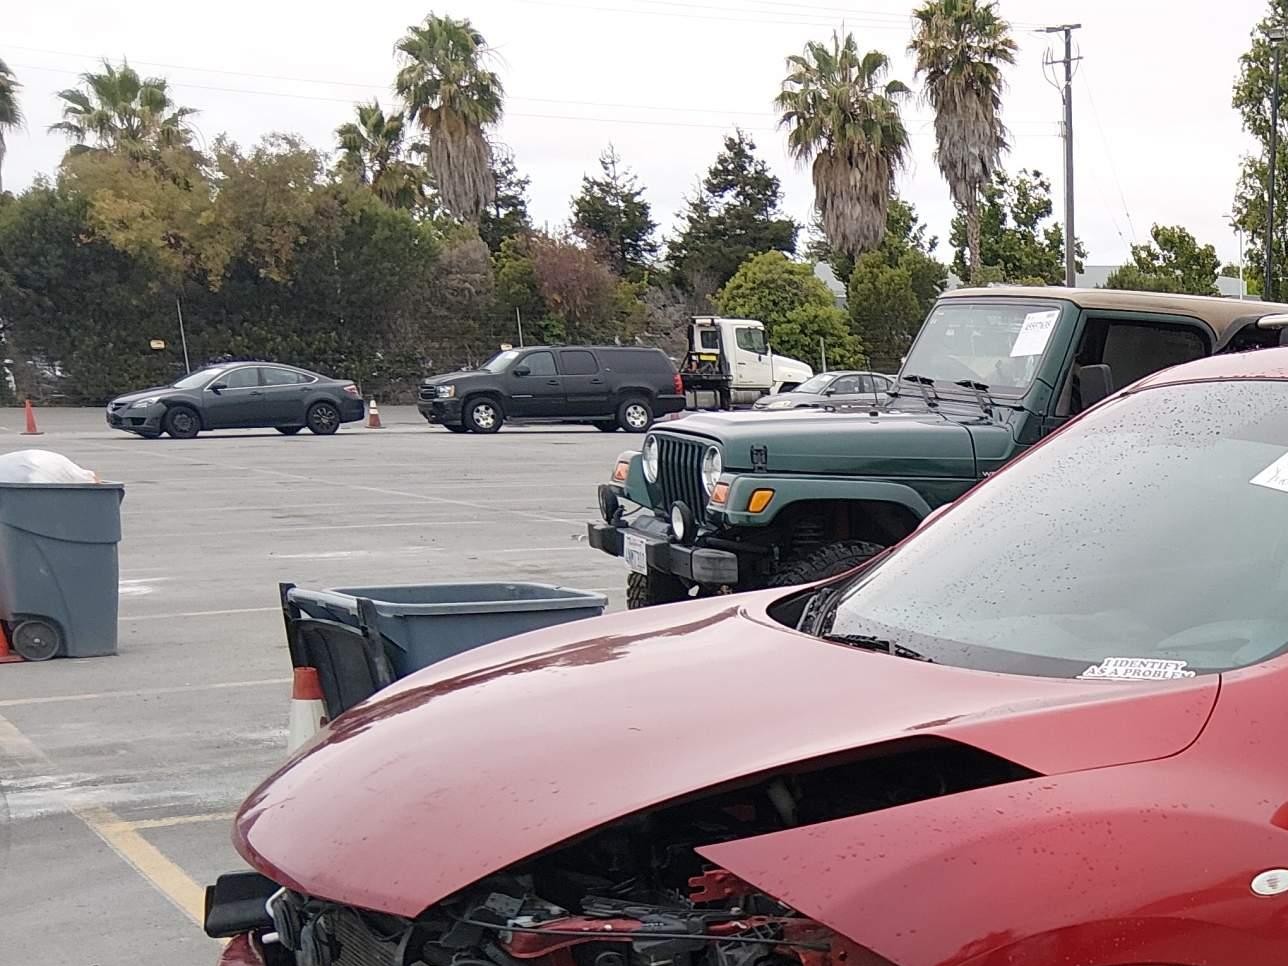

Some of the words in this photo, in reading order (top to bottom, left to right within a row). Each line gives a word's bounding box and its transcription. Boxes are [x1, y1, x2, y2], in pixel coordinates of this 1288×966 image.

[1112, 659, 1184, 671] IDENTIFY
[1086, 666, 1108, 675] AS
[1109, 667, 1120, 676] A
